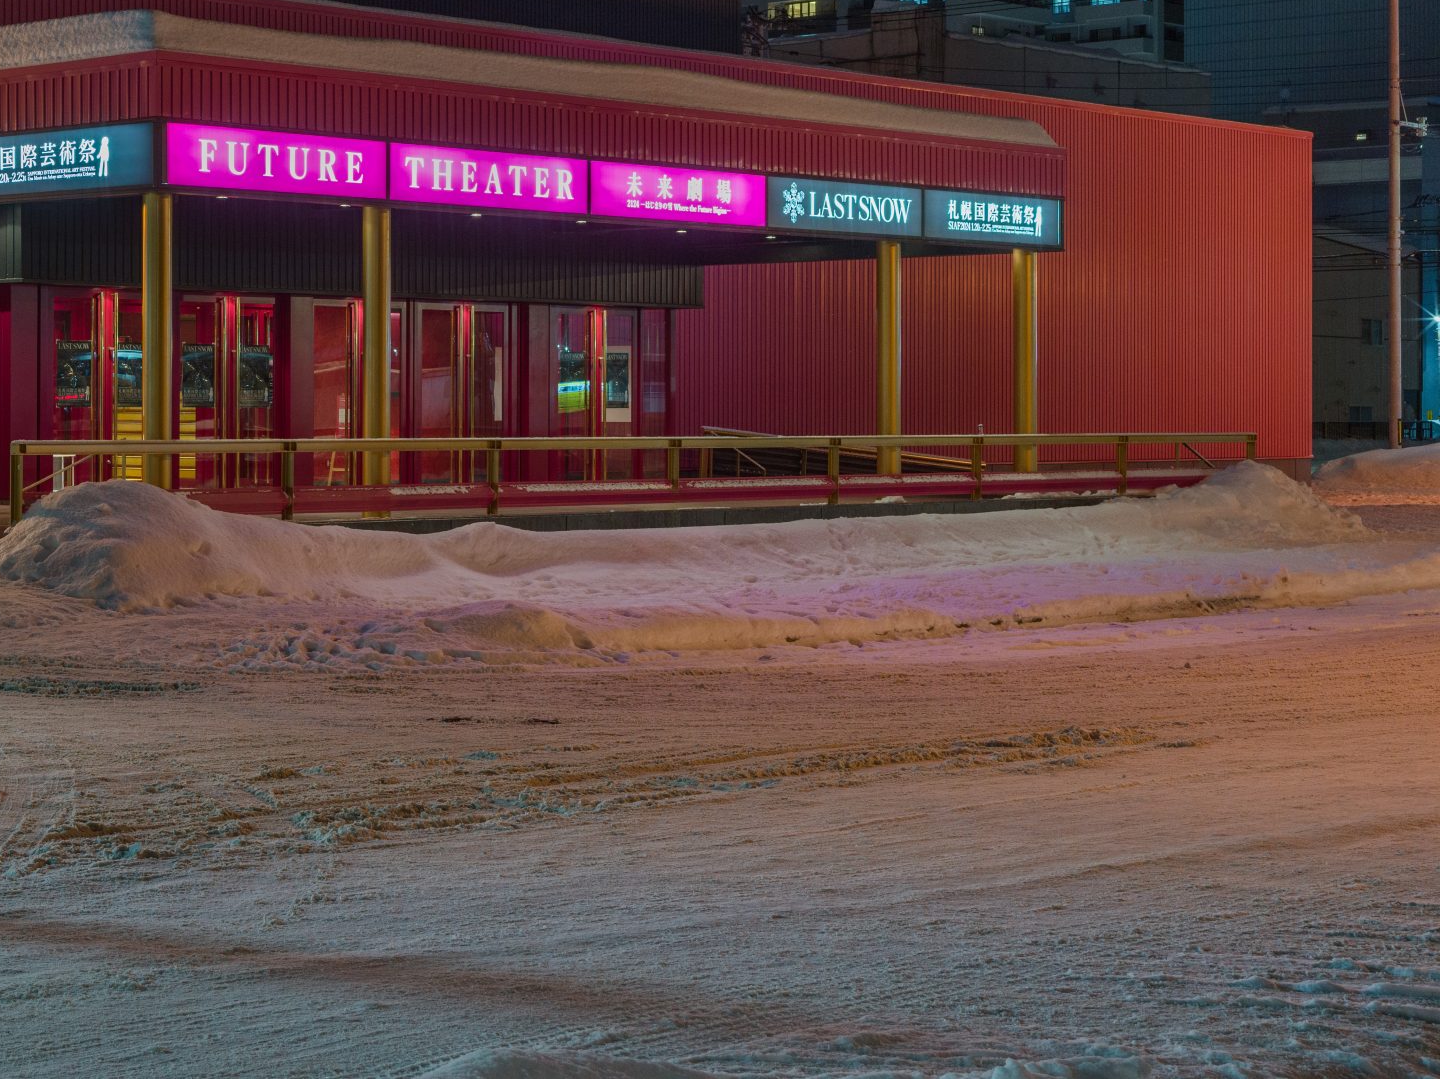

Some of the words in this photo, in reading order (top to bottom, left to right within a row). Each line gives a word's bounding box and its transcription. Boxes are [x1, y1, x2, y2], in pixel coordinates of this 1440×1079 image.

[198, 139, 364, 184] FUTURE
[405, 156, 574, 200] THEATER
[626, 171, 732, 204] 未来劇場
[809, 191, 857, 219] LAST
[858, 195, 912, 224] SNOW
[948, 200, 1035, 225] 札幌国際芸術祭
